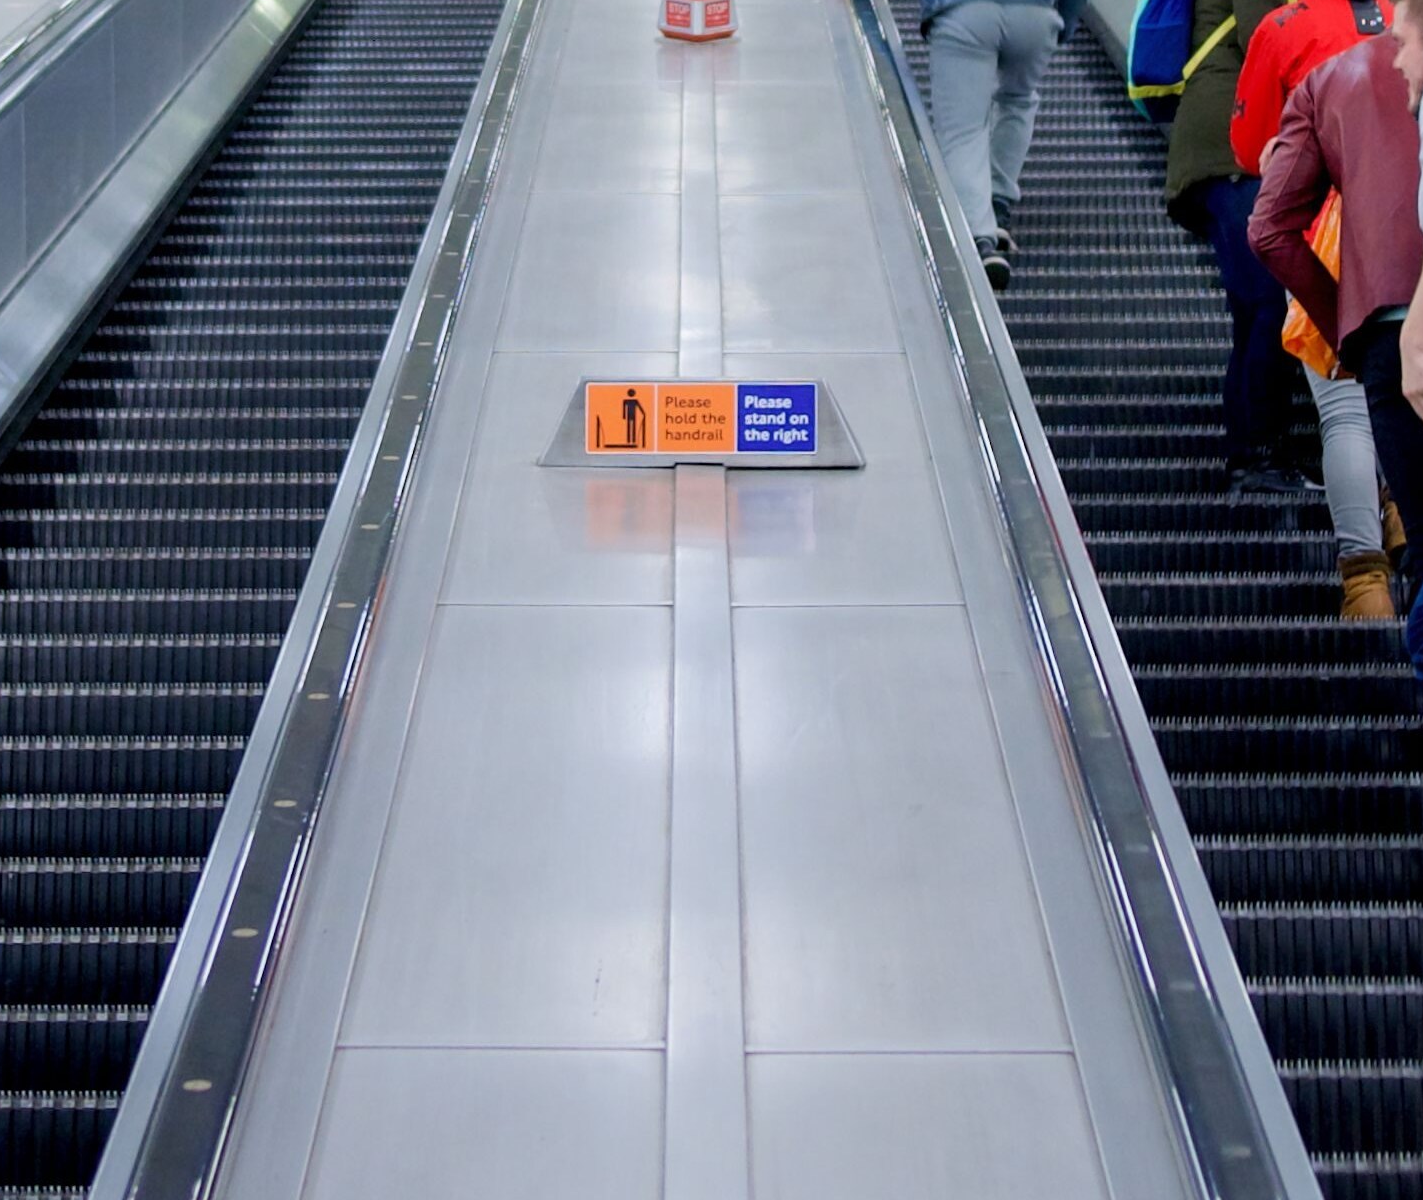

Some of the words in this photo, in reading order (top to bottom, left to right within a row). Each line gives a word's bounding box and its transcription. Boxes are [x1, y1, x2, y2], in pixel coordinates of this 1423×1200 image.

[707, 2, 729, 15] STOP
[665, 396, 711, 408] Please
[744, 395, 792, 409] Please
[665, 413, 696, 425] hold
[702, 413, 726, 425] the
[744, 412, 786, 425] stand
[789, 414, 809, 425] on
[665, 429, 723, 441] handrail
[744, 428, 770, 441] the
[773, 428, 809, 445] right
